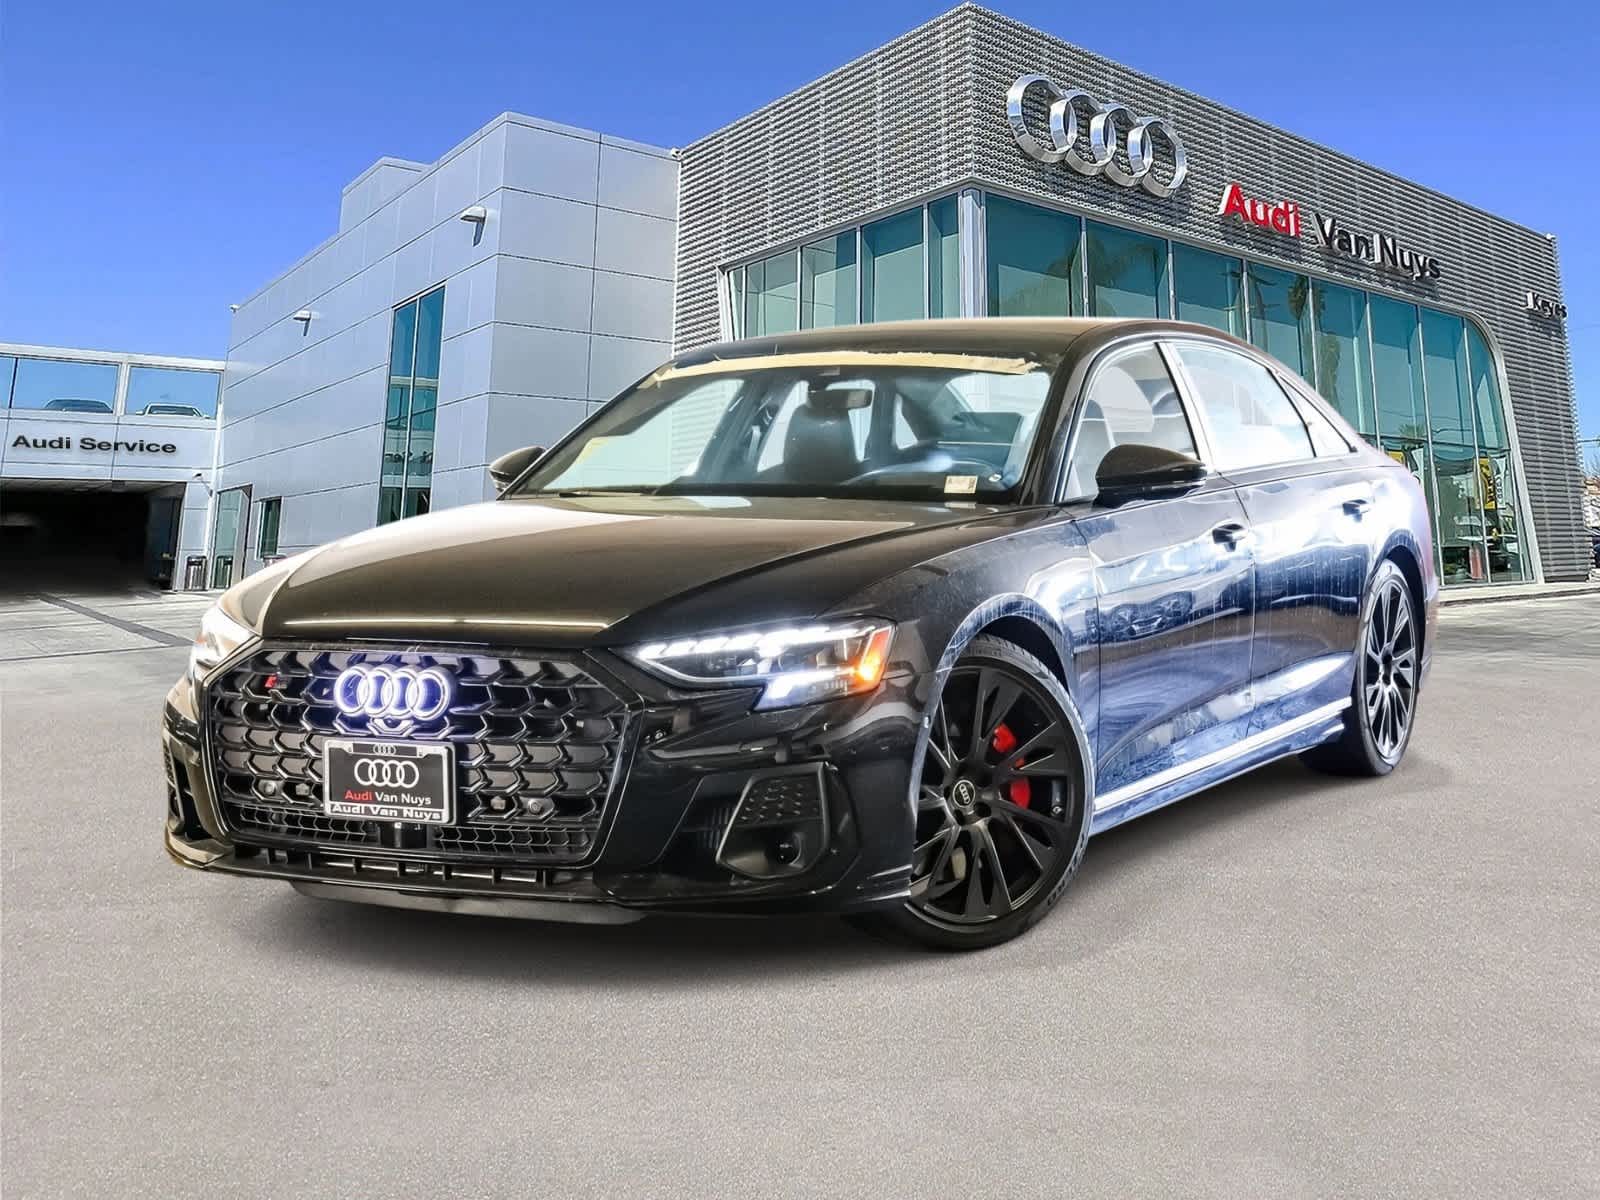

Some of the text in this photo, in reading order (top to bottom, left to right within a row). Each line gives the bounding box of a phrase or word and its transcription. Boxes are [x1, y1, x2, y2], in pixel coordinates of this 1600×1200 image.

[1219, 182, 1440, 280] Audi Van Nuys
[1528, 292, 1567, 318] Keyes
[12, 435, 177, 453] Audi Service
[345, 790, 432, 807] Audi Van Nuys
[332, 803, 441, 821] Audi Van Nuys
